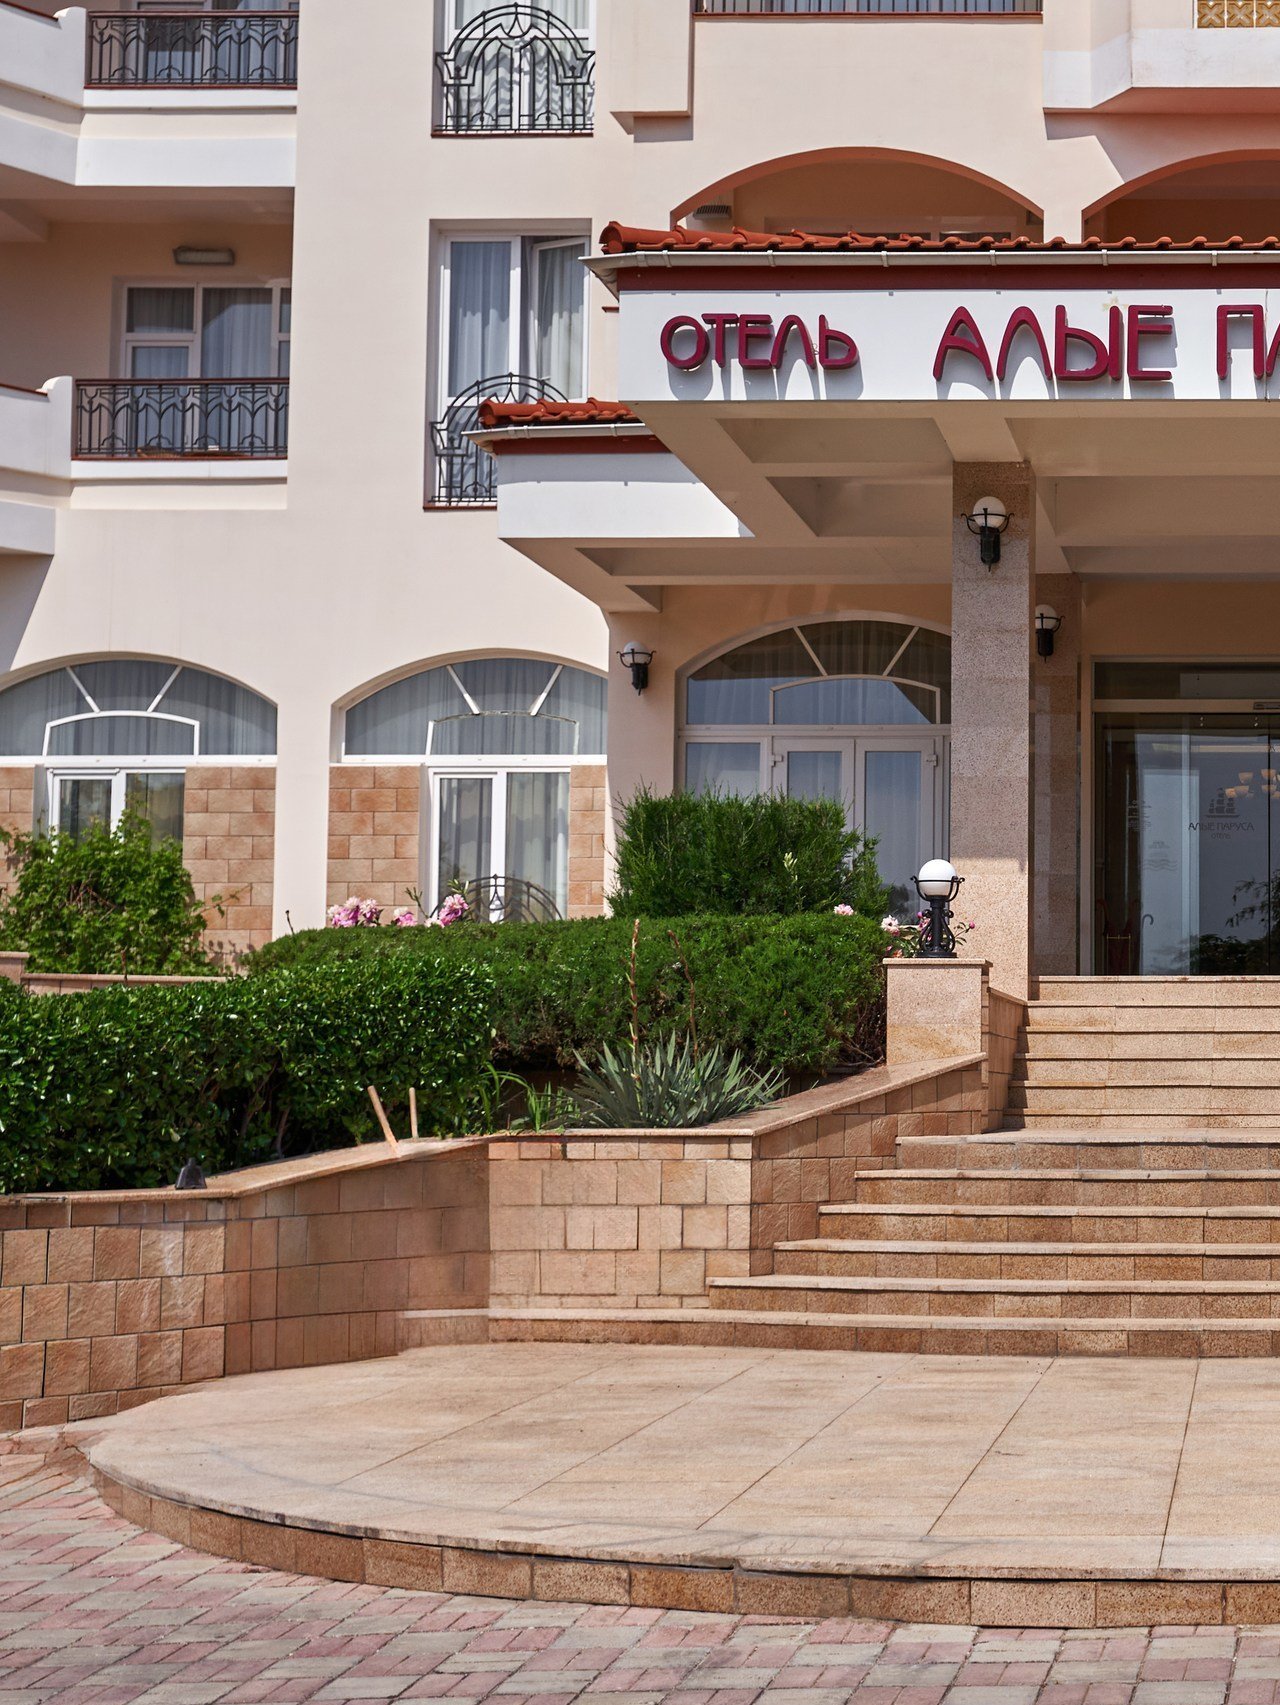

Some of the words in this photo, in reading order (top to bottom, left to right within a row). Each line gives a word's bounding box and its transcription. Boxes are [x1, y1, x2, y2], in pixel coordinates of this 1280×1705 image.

[660, 313, 859, 369] ОТЕЛЬ
[932, 304, 1174, 381] АЛЫЕ
[1216, 822, 1255, 831] ПАРУСА
